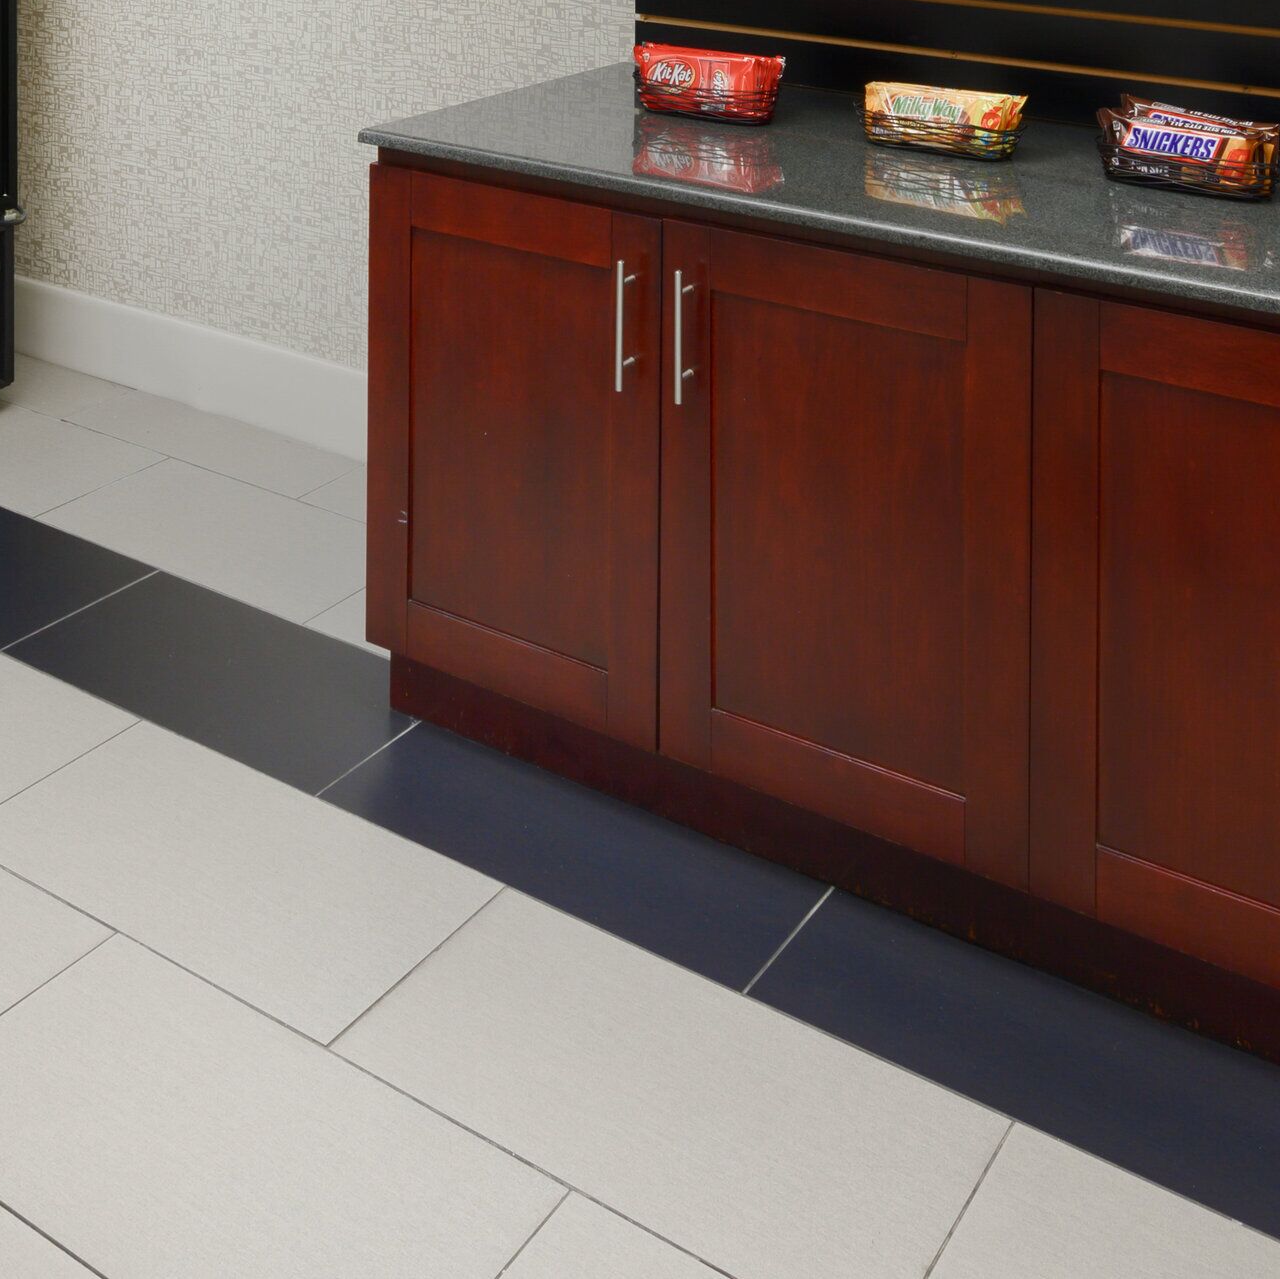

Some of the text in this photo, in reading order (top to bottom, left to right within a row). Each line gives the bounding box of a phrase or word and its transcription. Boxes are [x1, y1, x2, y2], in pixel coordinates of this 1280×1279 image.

[892, 95, 963, 124] Milky Way
[1127, 128, 1216, 158] SNICKERS
